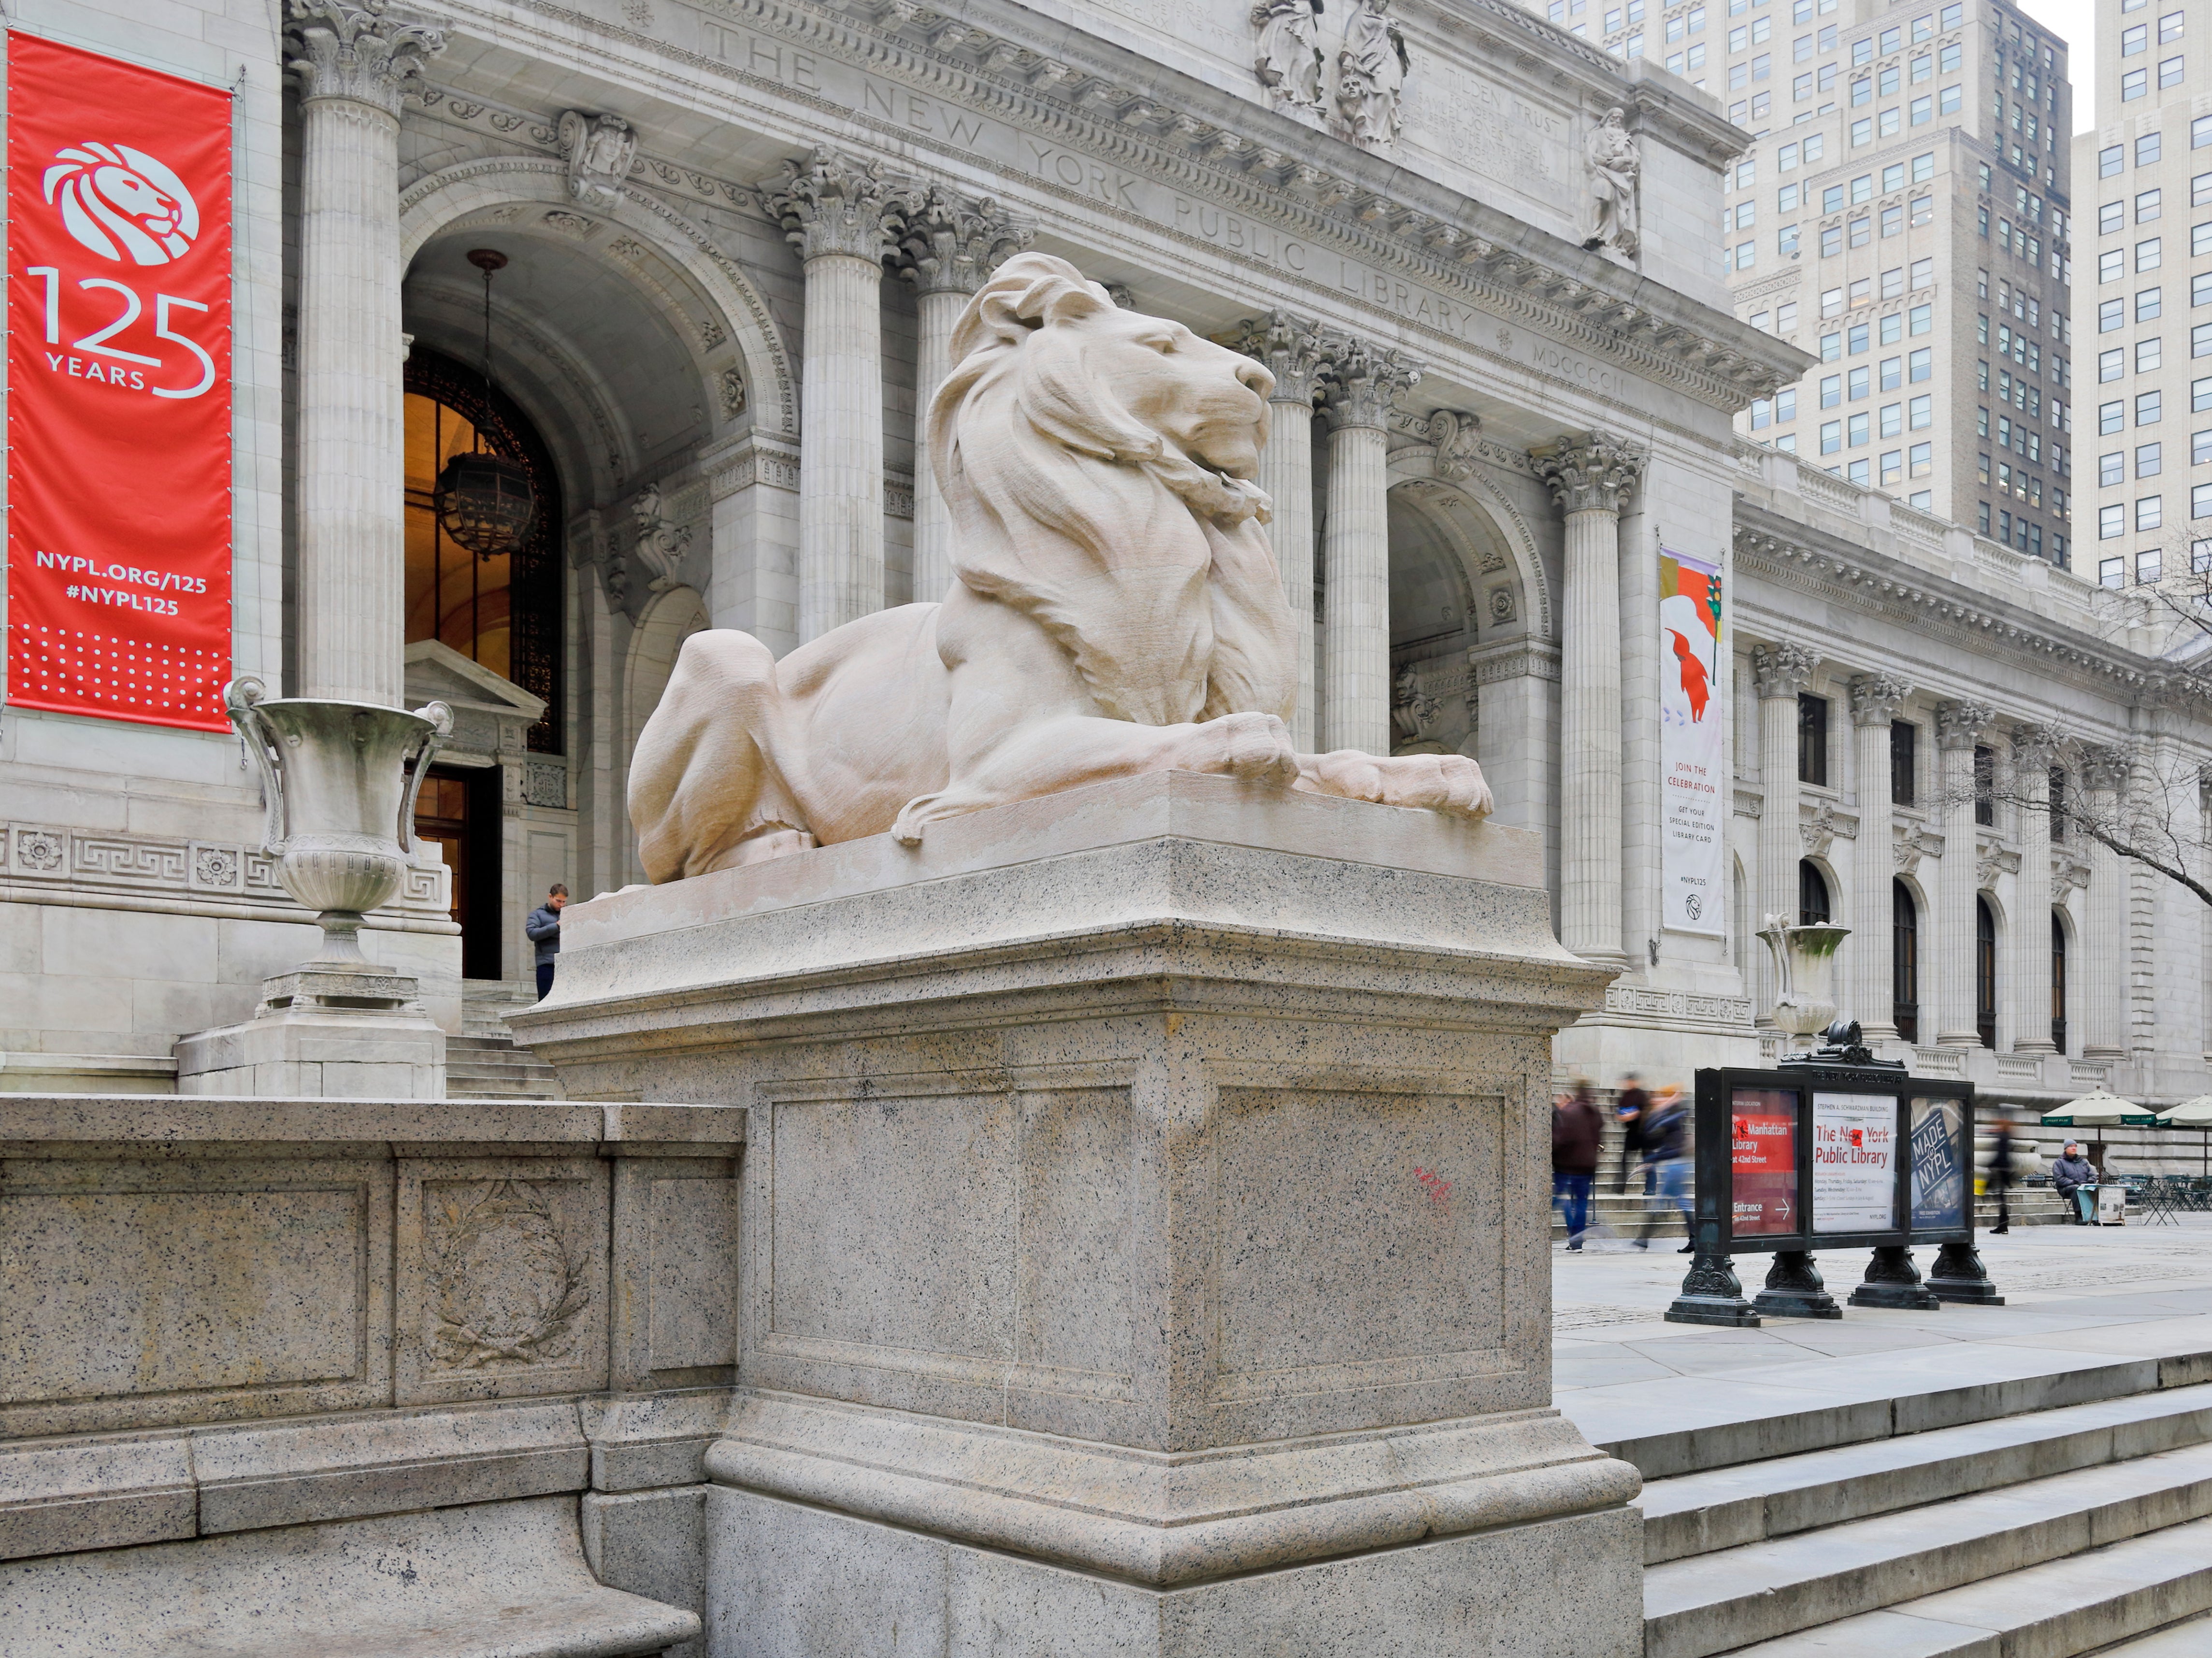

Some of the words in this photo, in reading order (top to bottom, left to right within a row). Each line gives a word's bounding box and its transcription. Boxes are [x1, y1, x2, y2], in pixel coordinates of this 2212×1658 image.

[1175, 10, 1203, 32] FINE
[1209, 26, 1240, 47] ARTS
[1445, 67, 1501, 109] TILDEN
[1514, 100, 1561, 138] TRUST
[1450, 93, 1495, 123] FOUNDED
[1401, 112, 1439, 138] CIENCE
[1408, 102, 1422, 115] TO
[1428, 112, 1457, 133] SERVE
[1463, 127, 1481, 144] THE
[1418, 91, 1463, 123] SAMUEL
[1468, 115, 1504, 142] JONES
[704, 21, 821, 92] THE
[862, 77, 984, 146] NEW
[1025, 139, 1139, 210] YORK
[1174, 196, 1306, 271] PUBLIC
[1339, 260, 1473, 338] LIBRARY
[1532, 343, 1625, 396] MDCCCCII
[27, 266, 216, 400] 125
[45, 351, 145, 391] YEARS
[36, 550, 207, 595] NYPL.ORG/125
[66, 584, 179, 616] #NYPL125
[1675, 762, 1692, 773] JOIN
[1695, 766, 1707, 776] THE
[1668, 776, 1715, 794] CELEBRATION
[1669, 817, 1690, 827] SPECIAL
[1692, 821, 1715, 831] EDITION
[1689, 808, 1705, 816] YOUR
[1672, 830, 1695, 841] LIBRARY
[1695, 835, 1712, 843] CARD
[1681, 876, 1706, 886] #NYPL125
[1812, 1070, 1824, 1080] THE
[1826, 1071, 1841, 1081] NEW
[1842, 1072, 1859, 1082] YORK
[1860, 1072, 1880, 1083] PUBLIC
[1881, 1074, 1904, 1084] LIBRARY
[1732, 1138, 1758, 1154] Library
[1817, 1124, 1836, 1142] The
[1840, 1126, 1857, 1142] Ne
[1867, 1126, 1889, 1143] York
[1912, 1118, 1945, 1160] MADE
[1816, 1146, 1848, 1164] Public
[1851, 1146, 1887, 1169] Library
[1929, 1148, 1935, 1157] AT
[1919, 1149, 1952, 1189] NYPL
[1734, 1202, 1763, 1212] Entrance
